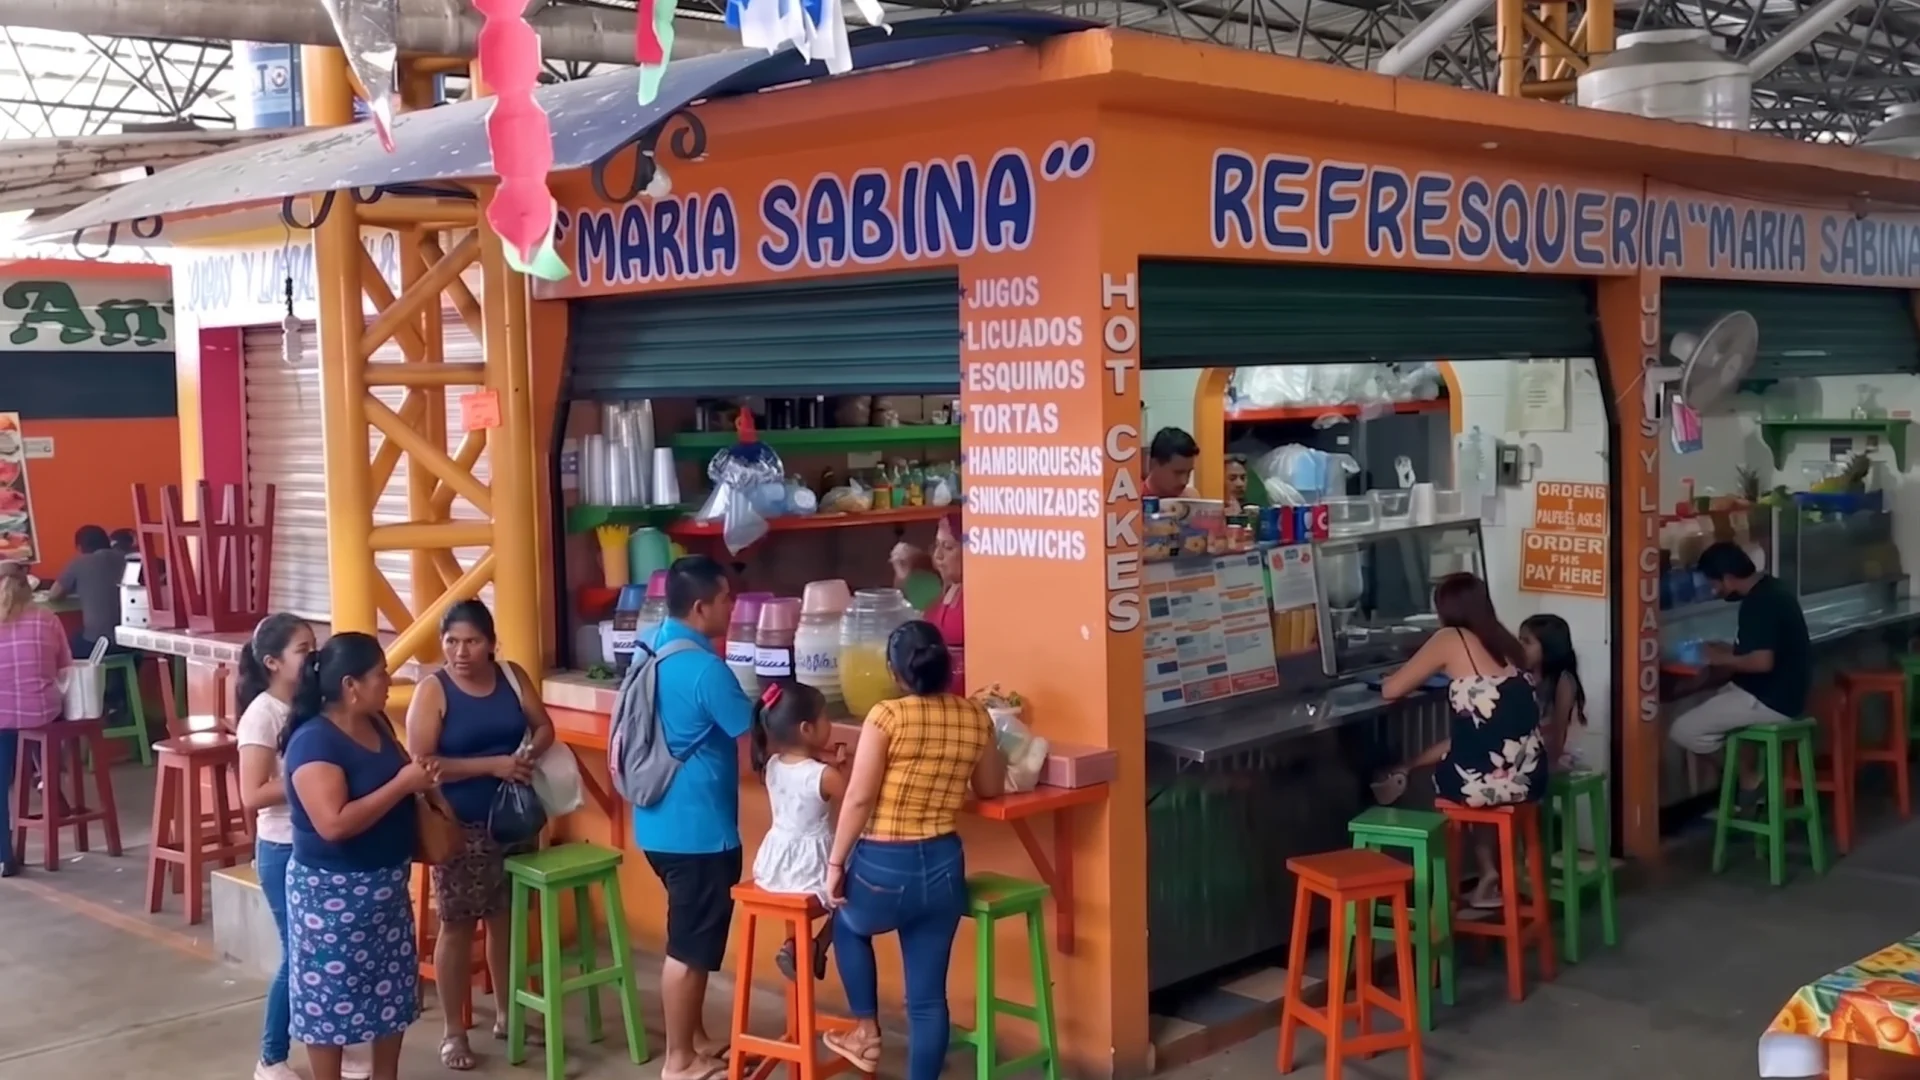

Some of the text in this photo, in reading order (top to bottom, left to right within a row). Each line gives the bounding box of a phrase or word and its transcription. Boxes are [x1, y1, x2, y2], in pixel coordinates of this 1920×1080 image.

[1210, 148, 1684, 272] REFRESQUERIA
[968, 276, 1039, 309] JUGOS
[3, 280, 174, 347] An
[967, 316, 1083, 351] LICUADOS
[1102, 272, 1137, 395] HOT
[968, 359, 1085, 393] ESQUIMOS
[970, 402, 1059, 434] TORTAS
[968, 526, 1086, 561] SANDWICHS
[1105, 423, 1141, 632] CAKES
[1527, 534, 1604, 555] ORDER
[1525, 563, 1603, 586] PAY HERE
[1640, 486, 1659, 722] LICUADOS
